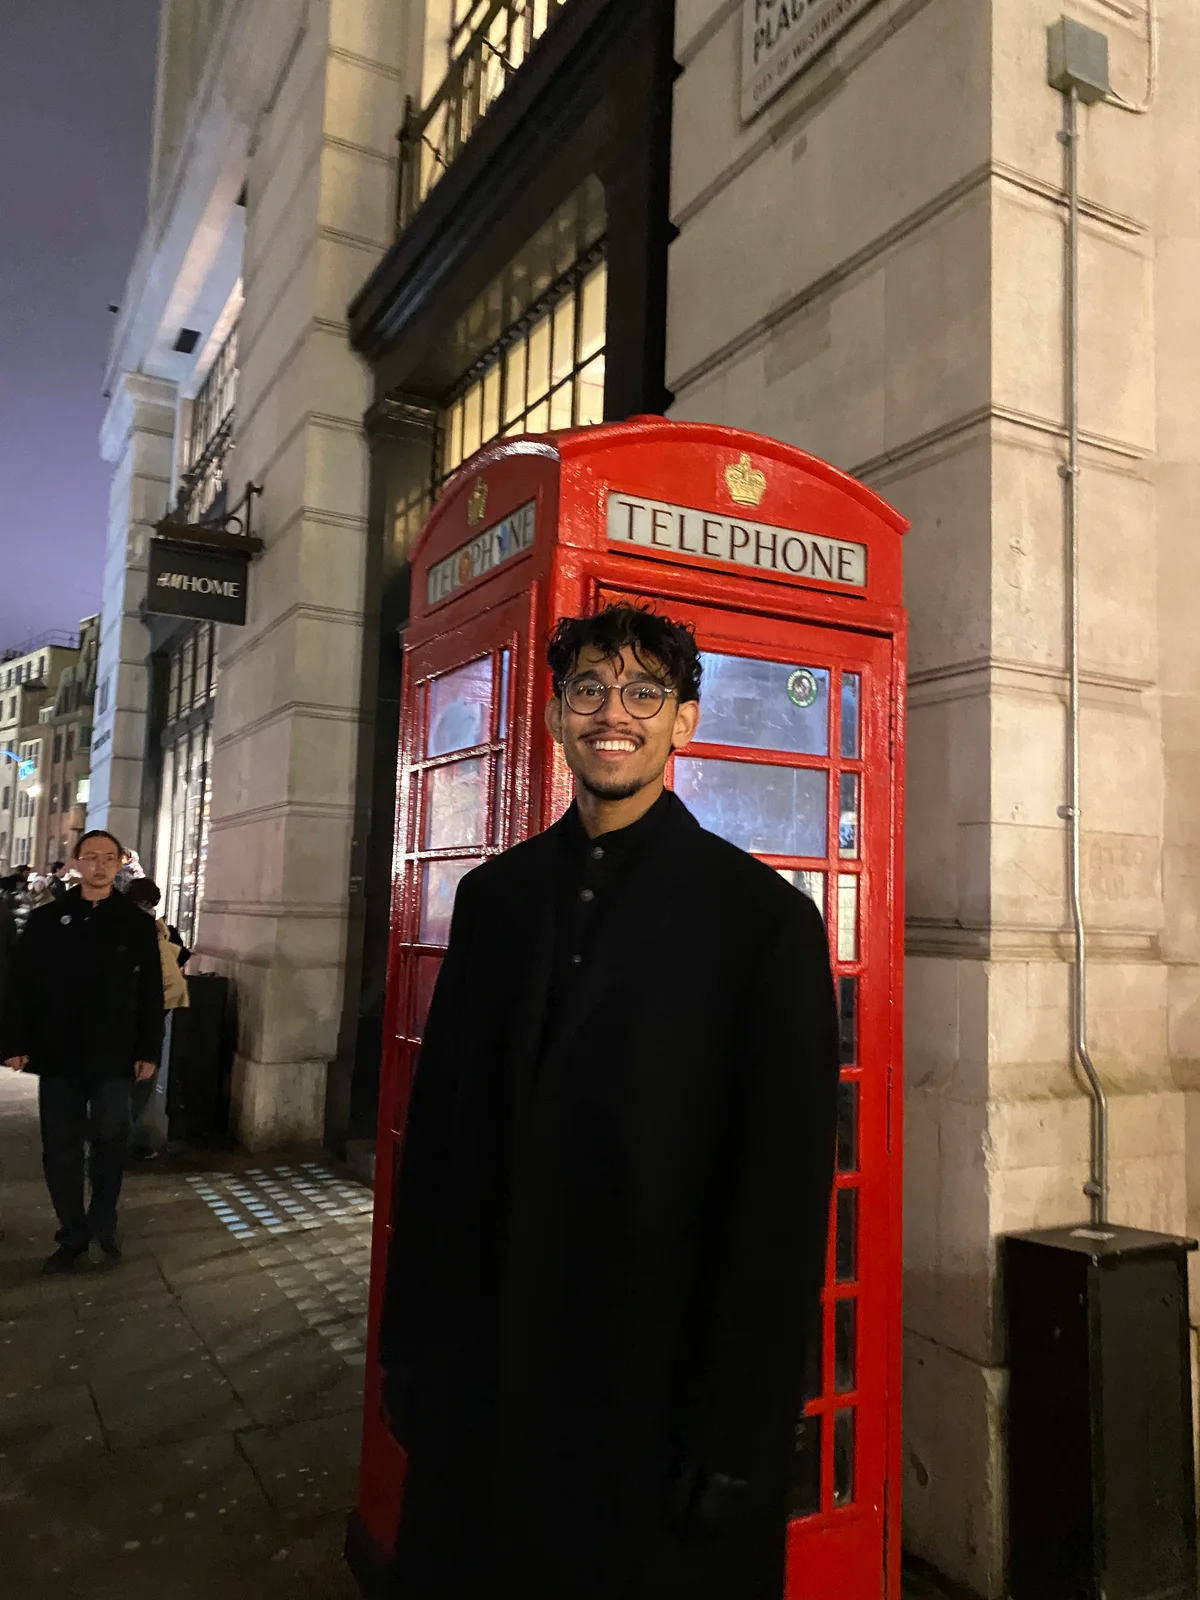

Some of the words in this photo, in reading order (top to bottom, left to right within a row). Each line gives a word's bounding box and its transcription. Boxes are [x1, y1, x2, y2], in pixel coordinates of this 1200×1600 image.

[754, 0, 816, 65] PLAC
[430, 503, 535, 600] TELPHNE
[618, 500, 856, 583] TELEPHONE
[182, 575, 240, 598] HOME
